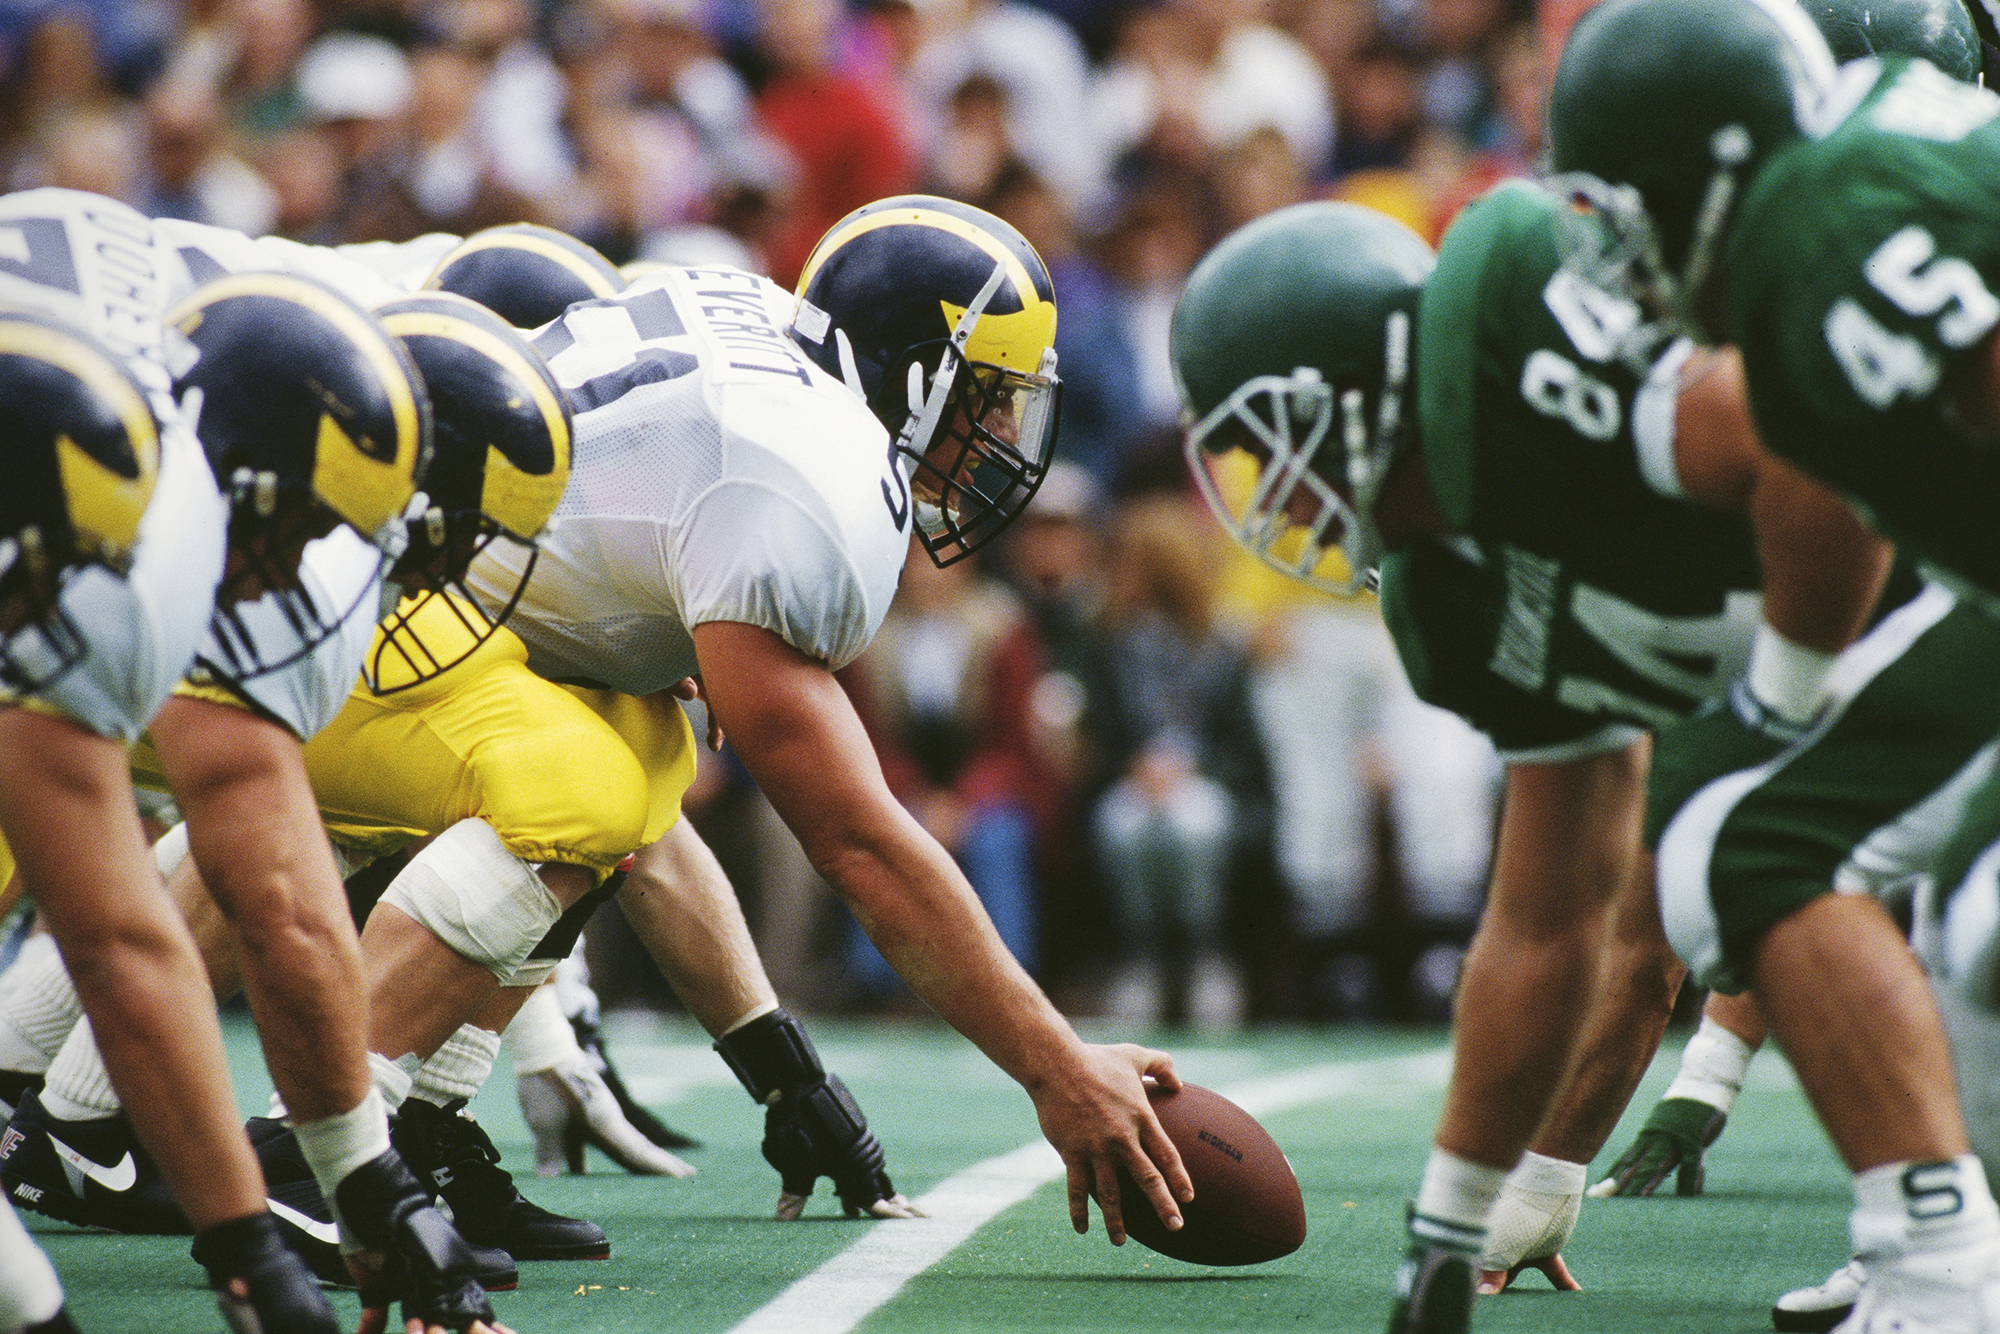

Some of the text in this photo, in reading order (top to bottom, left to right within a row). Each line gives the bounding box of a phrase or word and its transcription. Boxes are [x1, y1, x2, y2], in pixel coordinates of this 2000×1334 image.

[685, 268, 814, 388] EVERITT
[1521, 264, 1643, 442] 84
[1823, 224, 2000, 410] 45
[14, 1182, 44, 1202] NIKE
[1901, 1159, 1964, 1221] S
